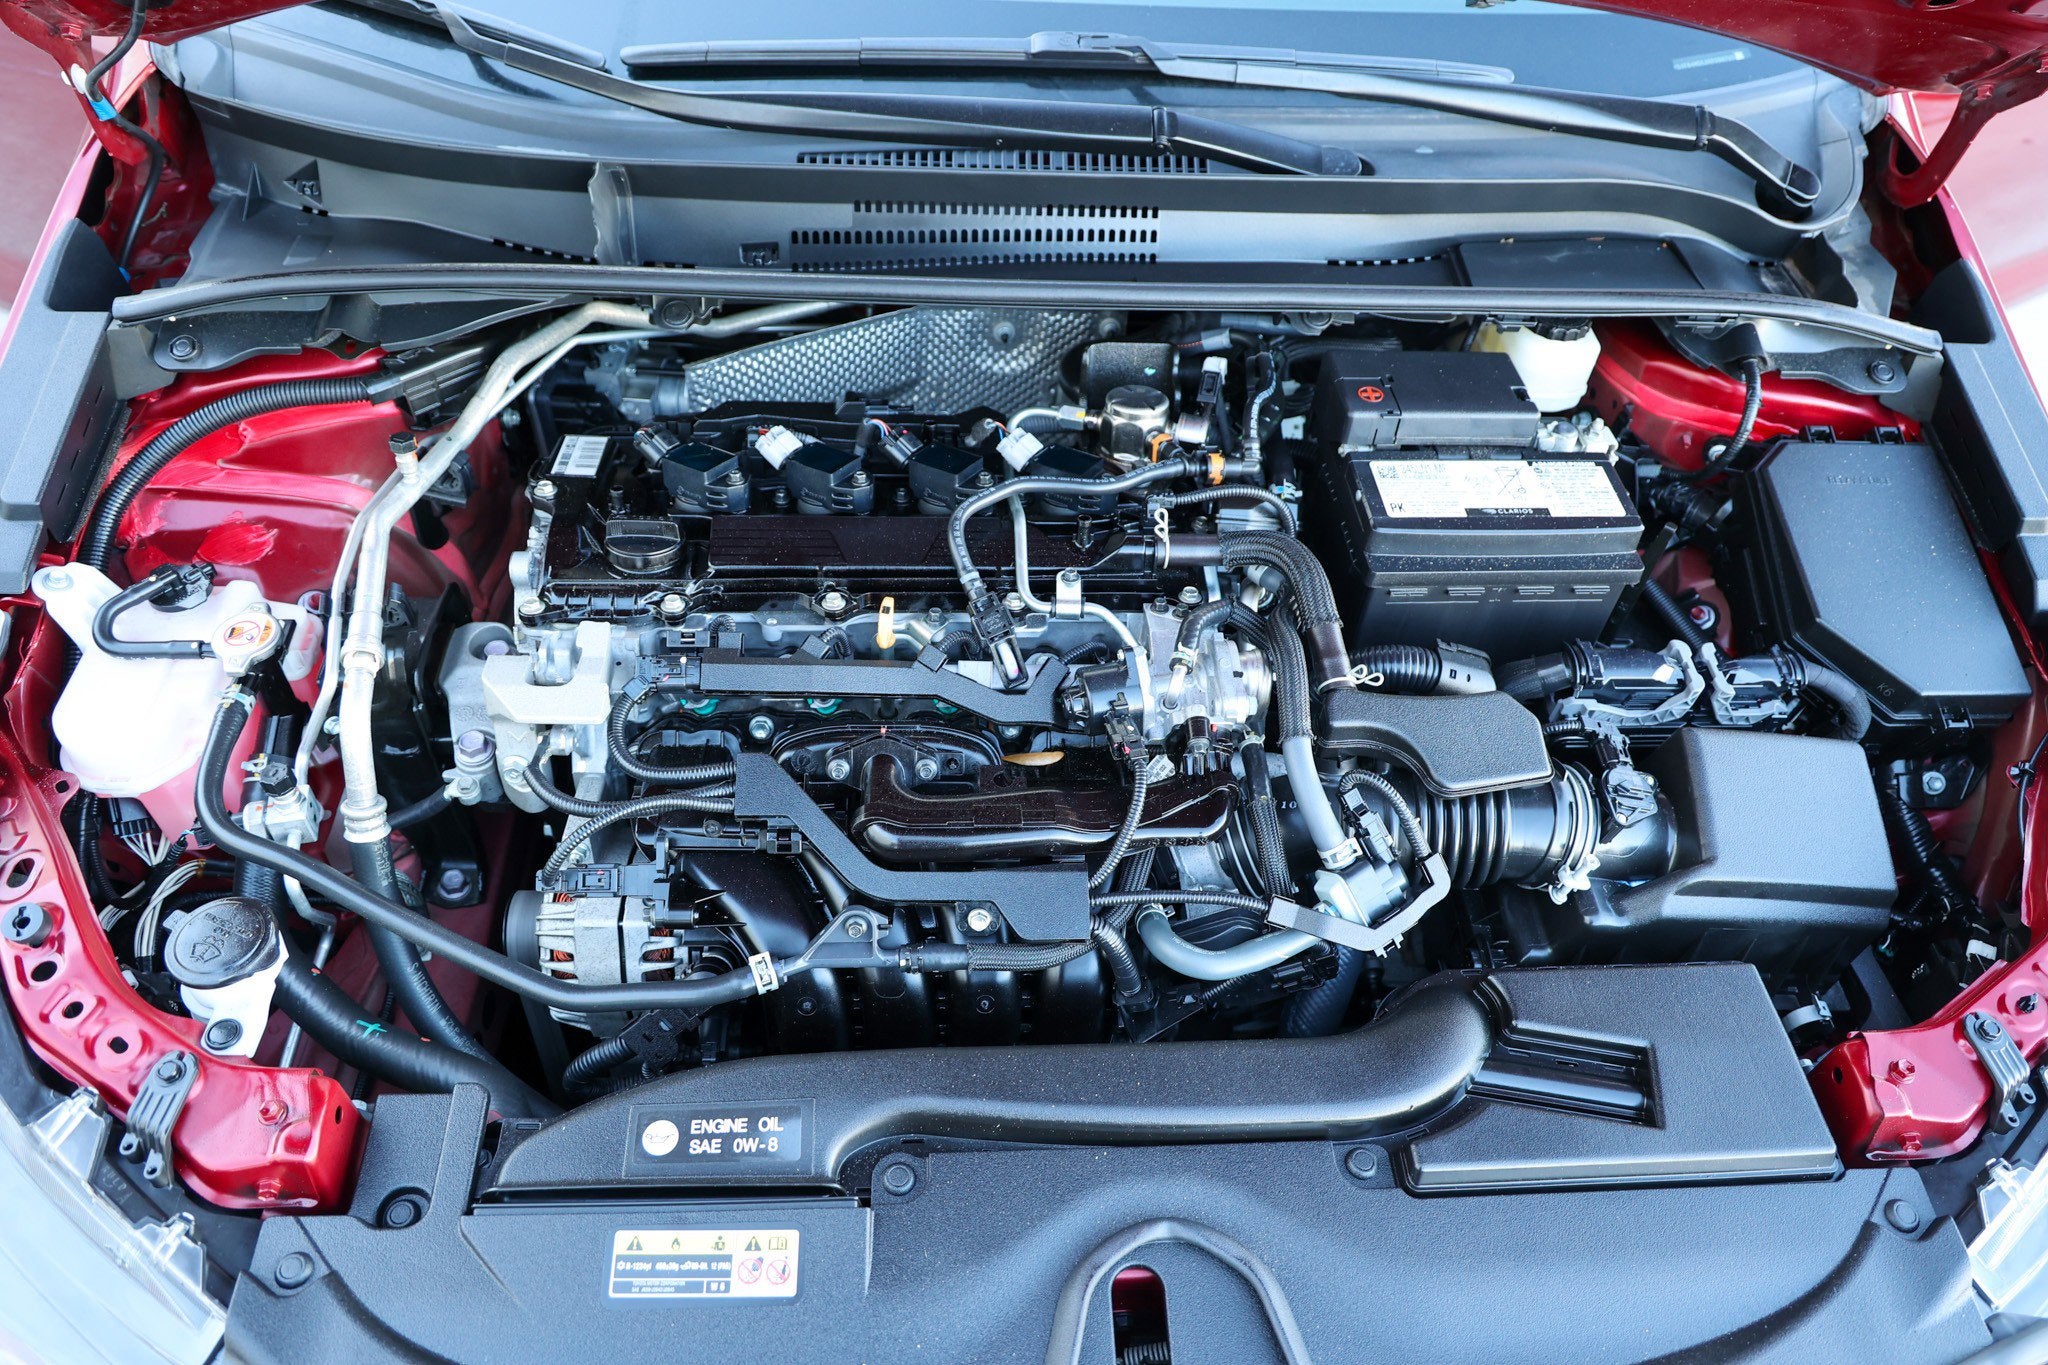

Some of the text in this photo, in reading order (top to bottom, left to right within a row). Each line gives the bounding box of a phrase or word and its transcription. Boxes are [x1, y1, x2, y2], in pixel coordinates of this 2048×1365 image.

[1389, 502, 1406, 513] PK
[690, 1116, 784, 1134] ENGINE OIL
[688, 1136, 779, 1155] SAE 0W-8
